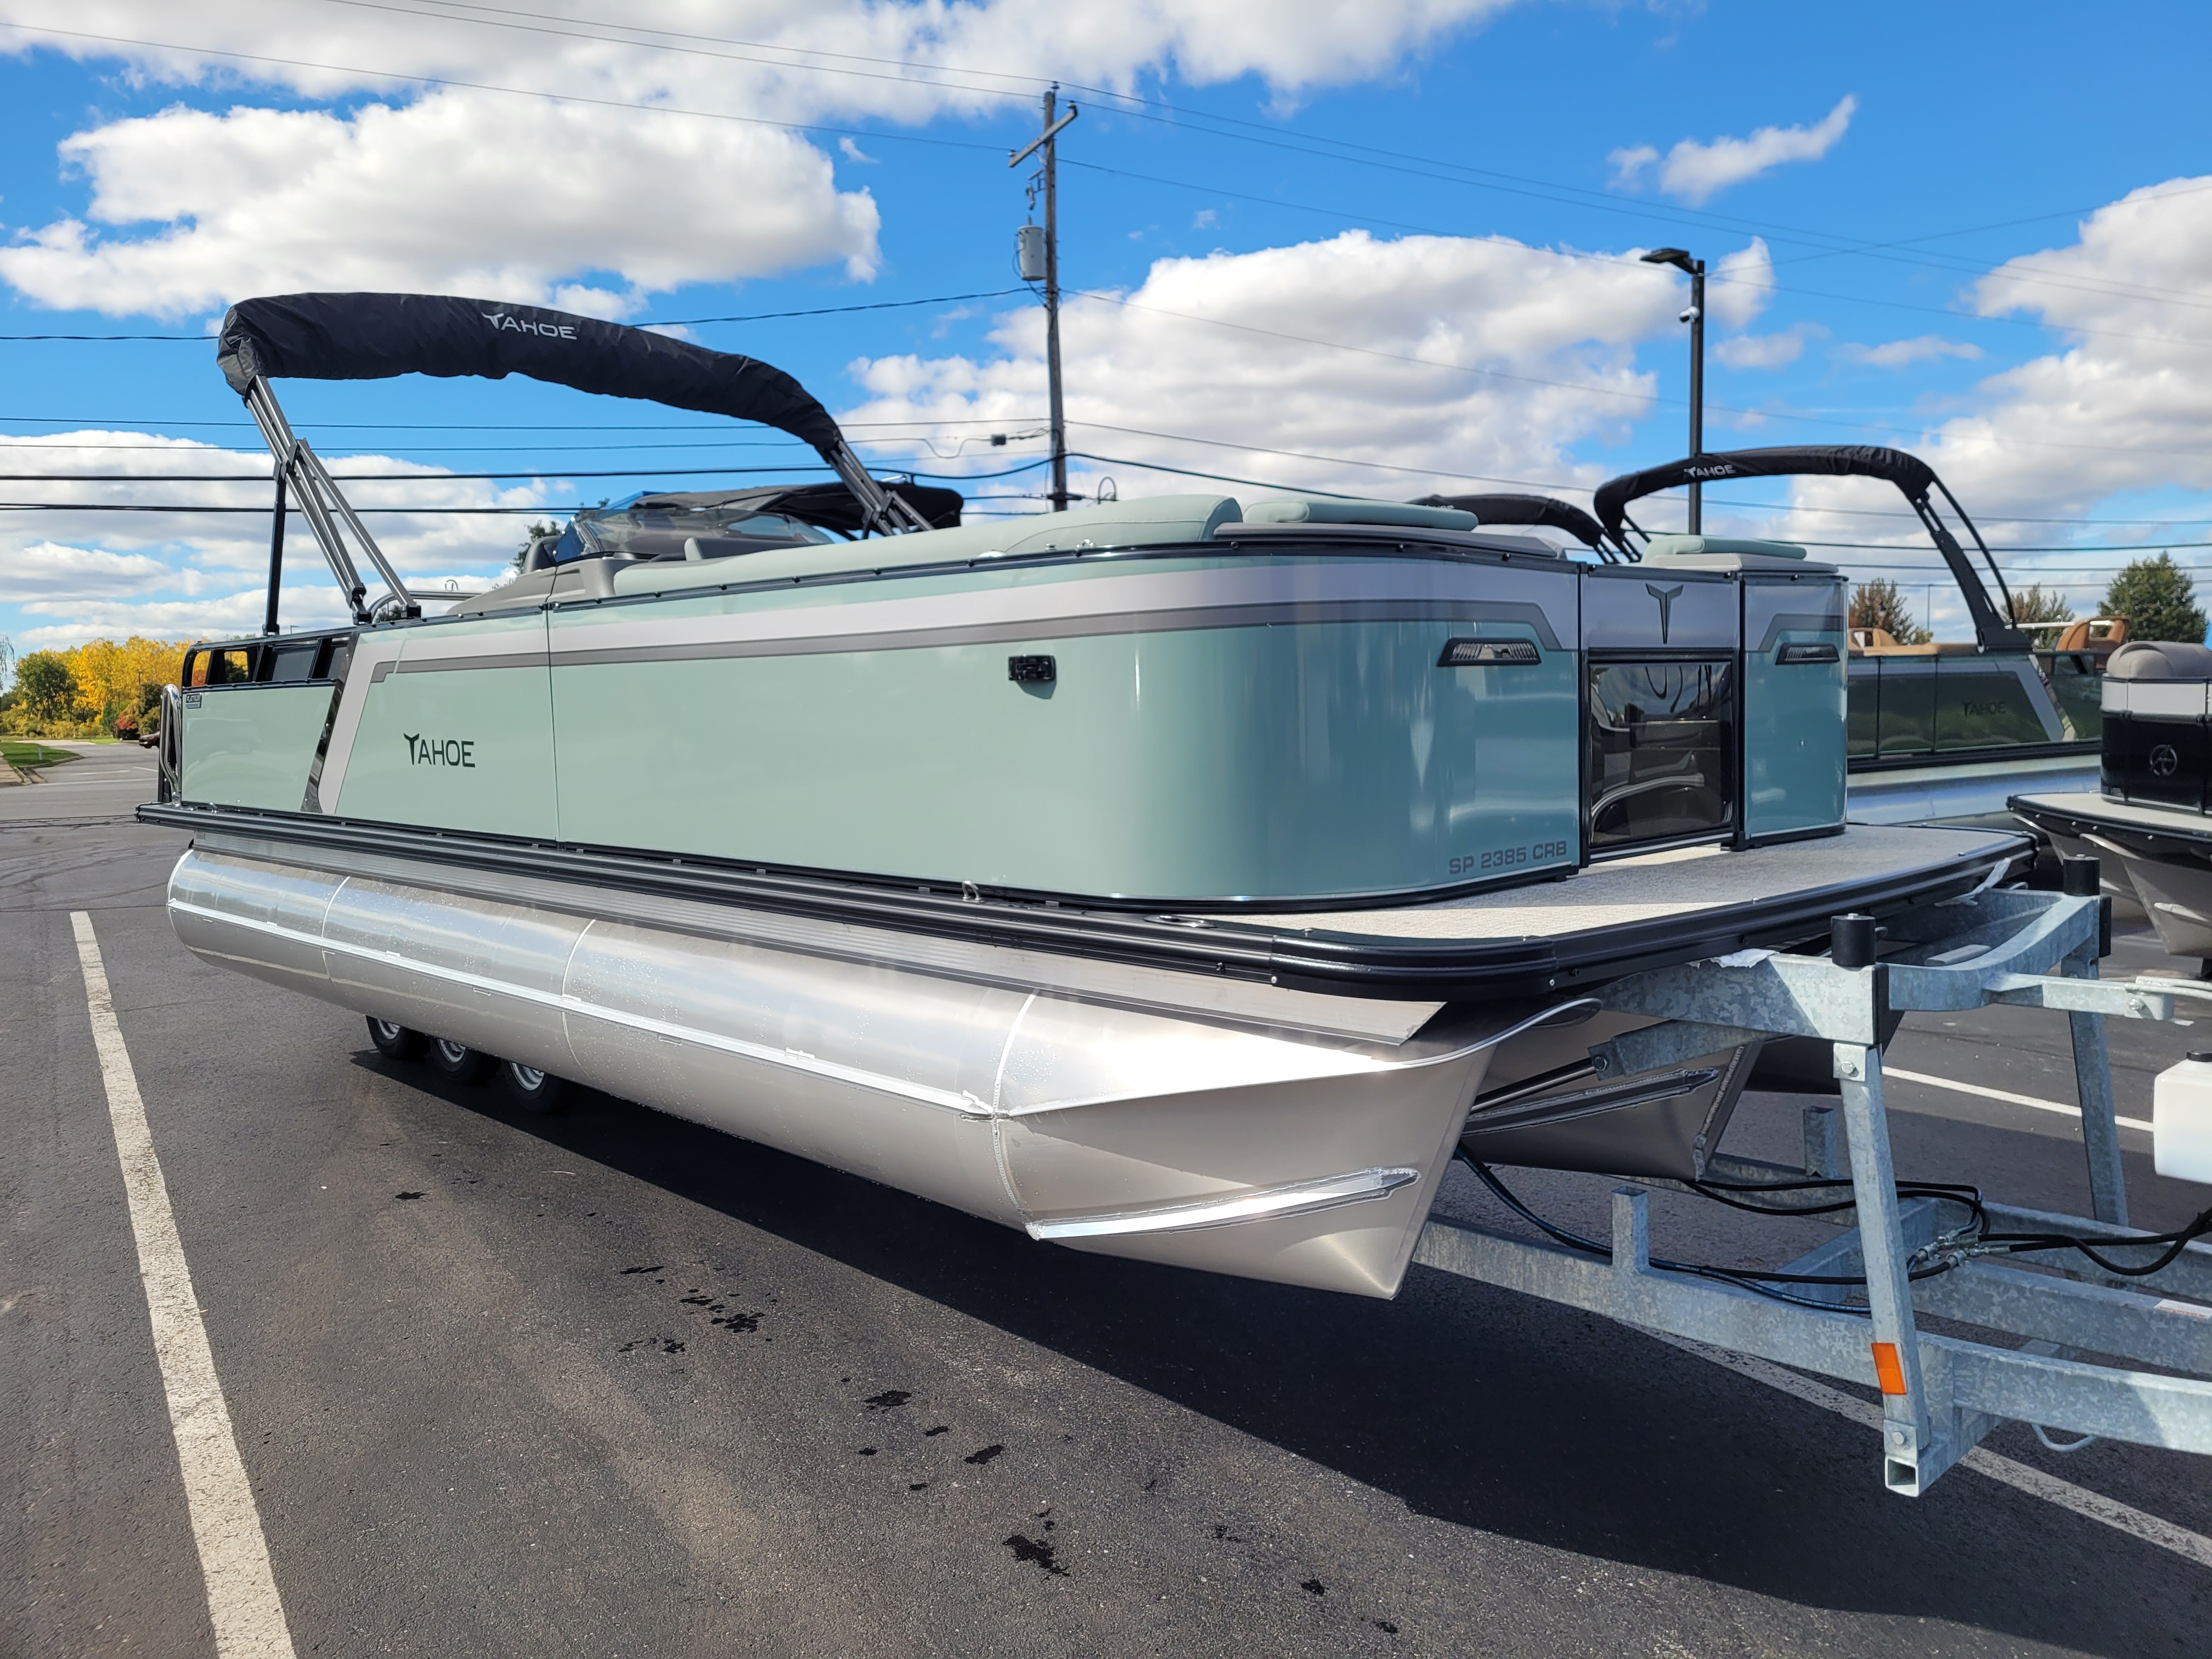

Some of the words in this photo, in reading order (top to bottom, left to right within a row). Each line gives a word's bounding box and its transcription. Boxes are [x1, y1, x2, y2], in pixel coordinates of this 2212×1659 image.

[481, 311, 577, 340] TAHOE
[1683, 464, 1737, 478] TAHOE
[403, 732, 476, 768] TAHOE
[1449, 855, 1474, 874] SP
[1481, 846, 1526, 869] 2385
[1533, 840, 1567, 860] CRB
